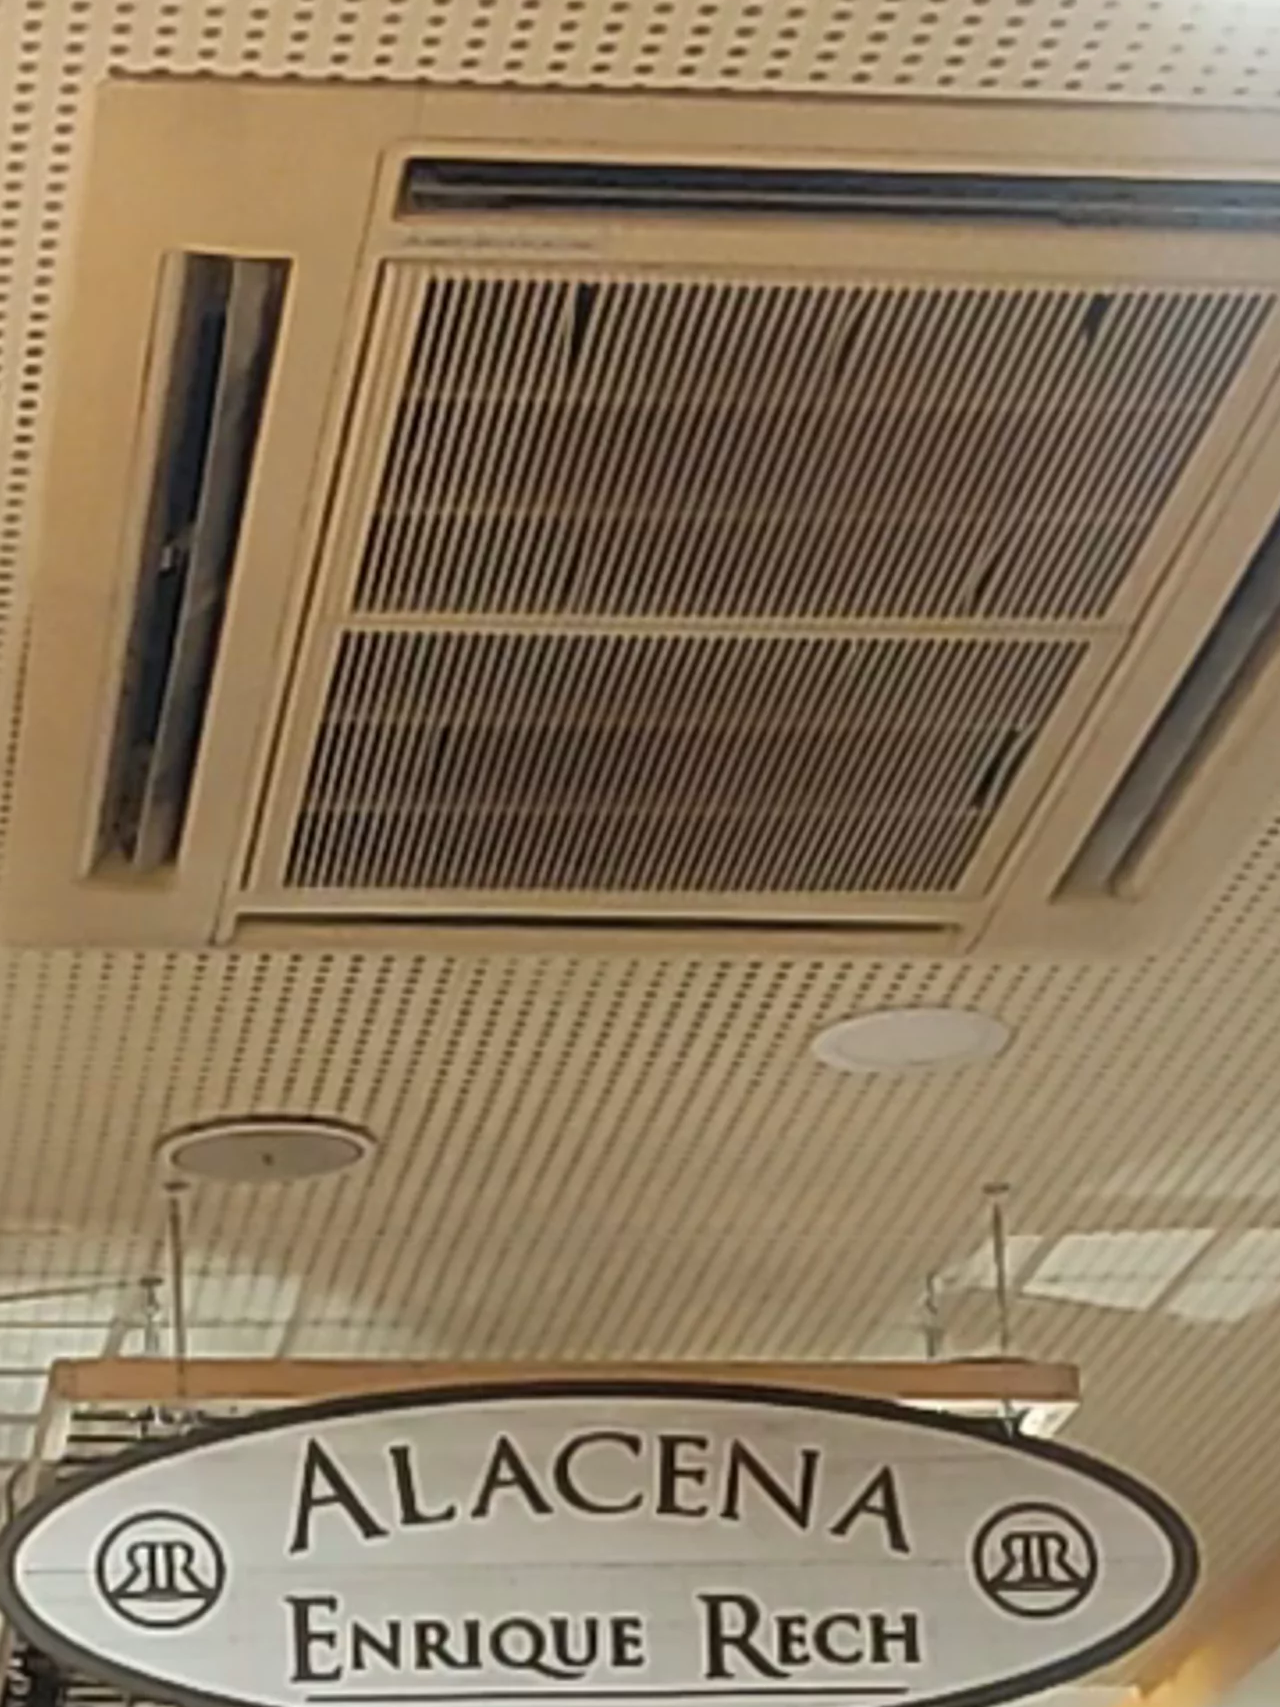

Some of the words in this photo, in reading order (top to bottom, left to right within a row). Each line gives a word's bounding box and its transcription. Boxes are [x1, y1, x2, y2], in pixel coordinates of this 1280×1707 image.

[289, 1431, 913, 1554] ALACENA
[287, 1595, 646, 1684] ENRIQUE
[699, 1591, 922, 1679] RECH
